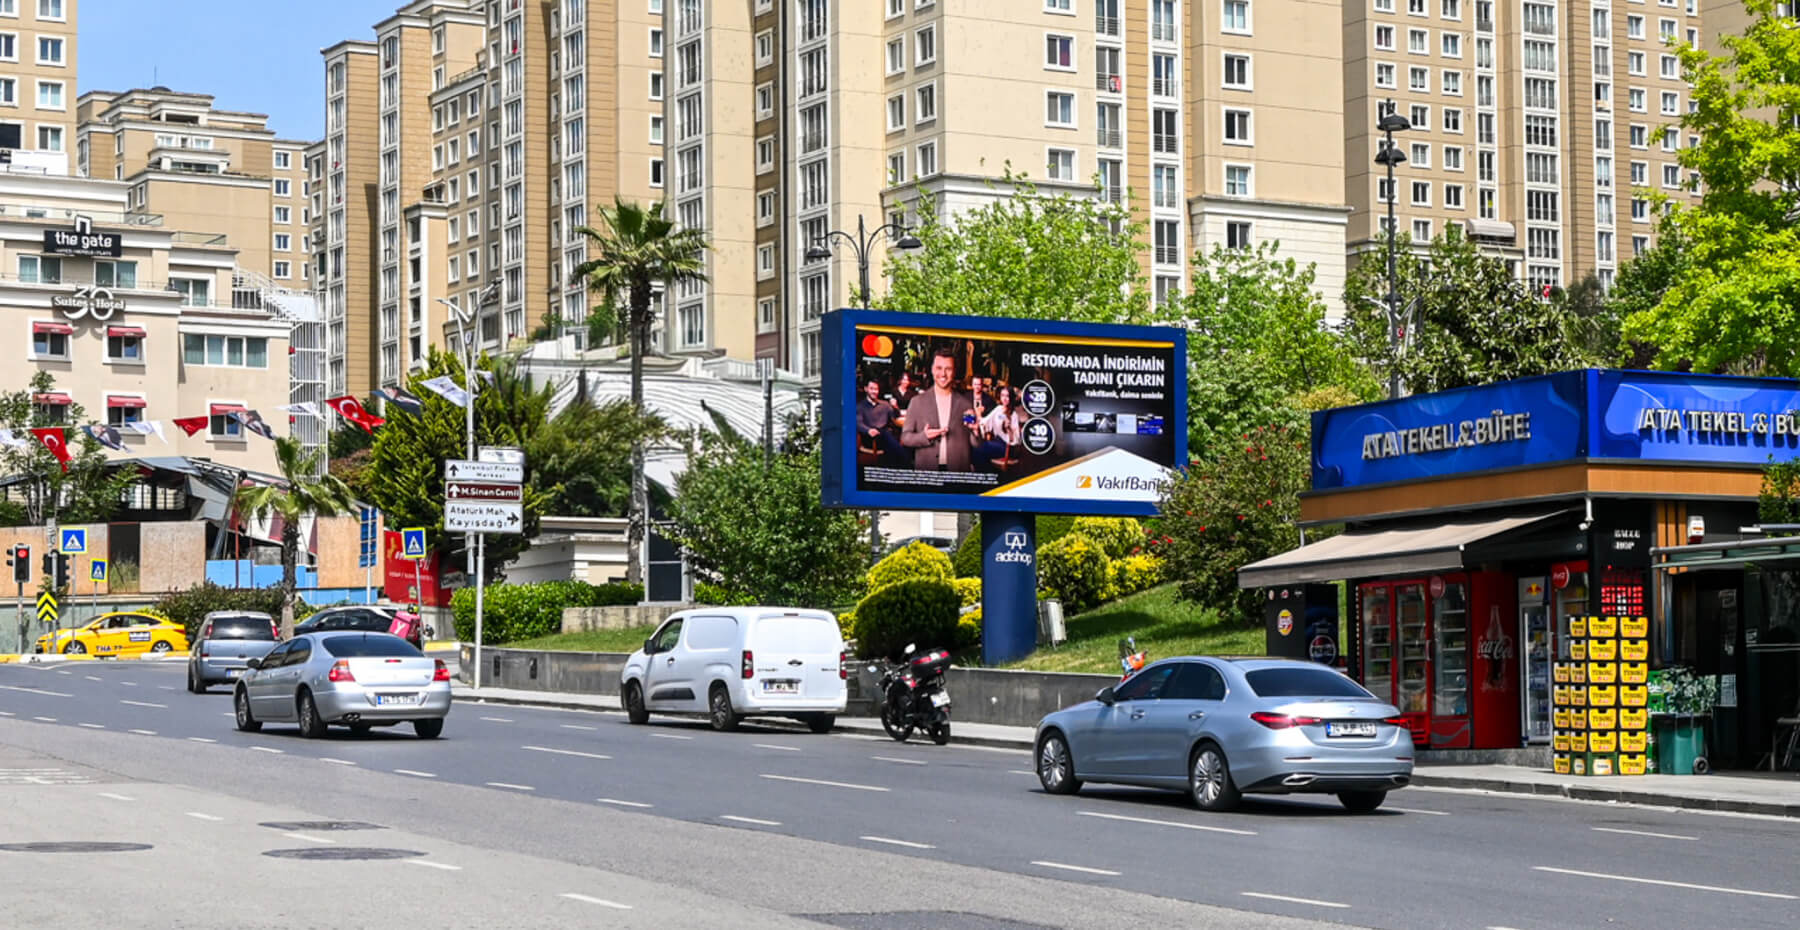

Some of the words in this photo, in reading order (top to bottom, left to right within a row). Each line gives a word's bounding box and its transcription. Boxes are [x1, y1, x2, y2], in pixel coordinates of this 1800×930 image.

[54, 231, 78, 246] the
[81, 234, 113, 249] gate
[54, 295, 88, 308] Suites
[96, 300, 125, 310] Hotel
[1021, 353, 1100, 370] RESTORANDA
[1103, 354, 1165, 372] İNDİRİMİN
[1073, 371, 1114, 385] TADINI
[1116, 373, 1165, 389] ÇIKARIN
[1638, 408, 1682, 430] ATA
[1688, 411, 1750, 432] TEKEL
[1752, 413, 1768, 433] &
[1361, 432, 1400, 460] ATA
[1398, 423, 1457, 454] TEKEL
[1457, 420, 1475, 446] &
[1475, 409, 1531, 443] BÜFE
[450, 506, 483, 515] Atatürk
